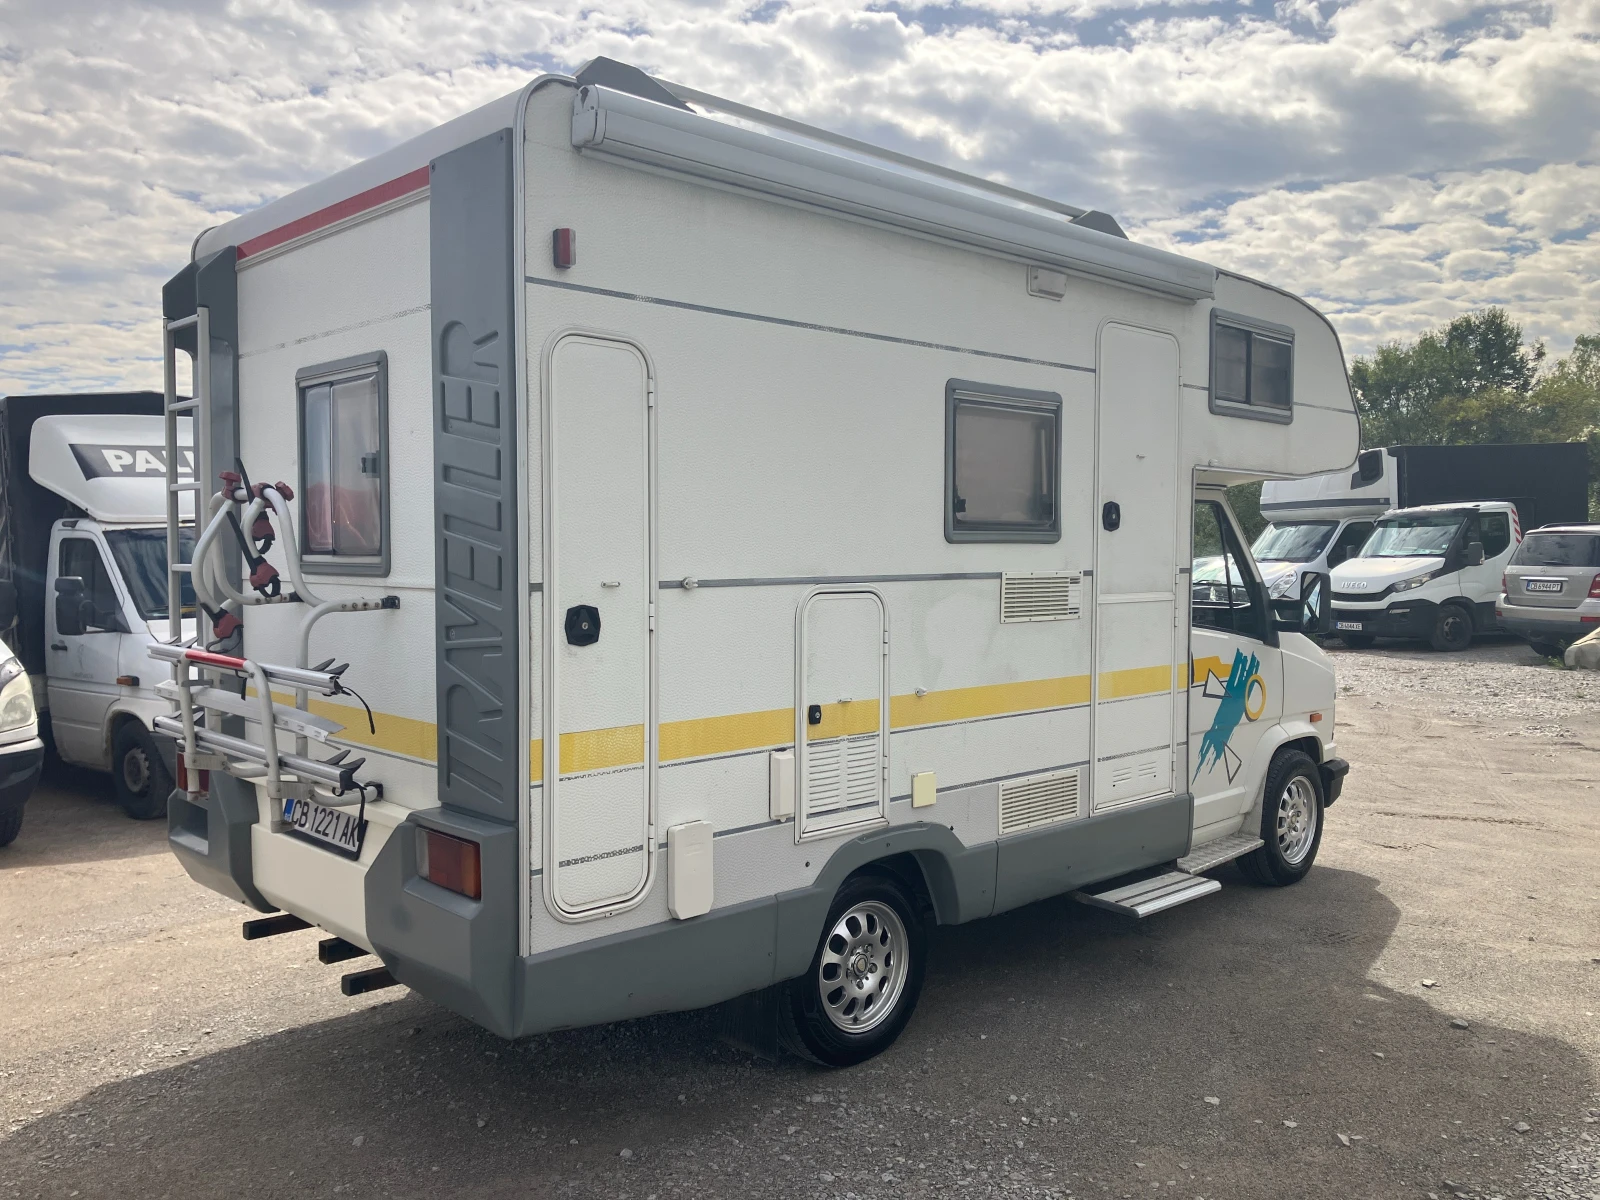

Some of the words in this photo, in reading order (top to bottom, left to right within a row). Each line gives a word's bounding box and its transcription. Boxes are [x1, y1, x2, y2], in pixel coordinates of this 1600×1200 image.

[440, 319, 503, 804] TRAVELLER
[1341, 581, 1367, 589] IVECO
[292, 800, 310, 828] CB
[311, 805, 341, 840] 1221
[339, 816, 360, 848] AK
